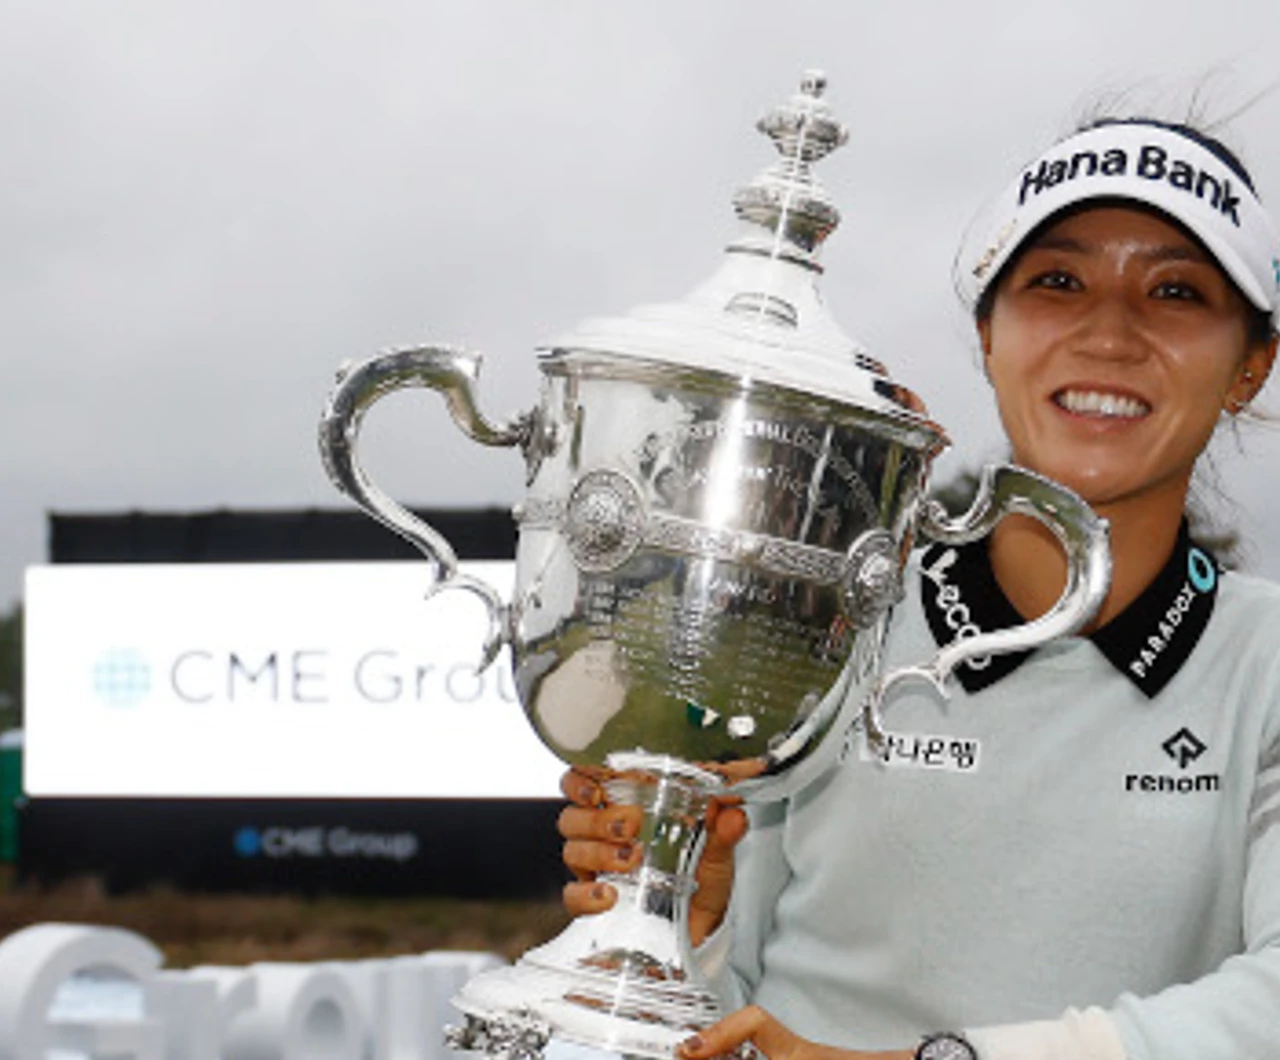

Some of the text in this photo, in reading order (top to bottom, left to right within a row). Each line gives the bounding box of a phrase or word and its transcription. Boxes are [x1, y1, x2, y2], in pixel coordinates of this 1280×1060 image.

[1019, 145, 1241, 228] Hana Bank
[1129, 582, 1198, 678] PARADOX
[170, 648, 517, 704] CME Grou
[1125, 774, 1224, 795] renom
[261, 827, 419, 860] CME Group
